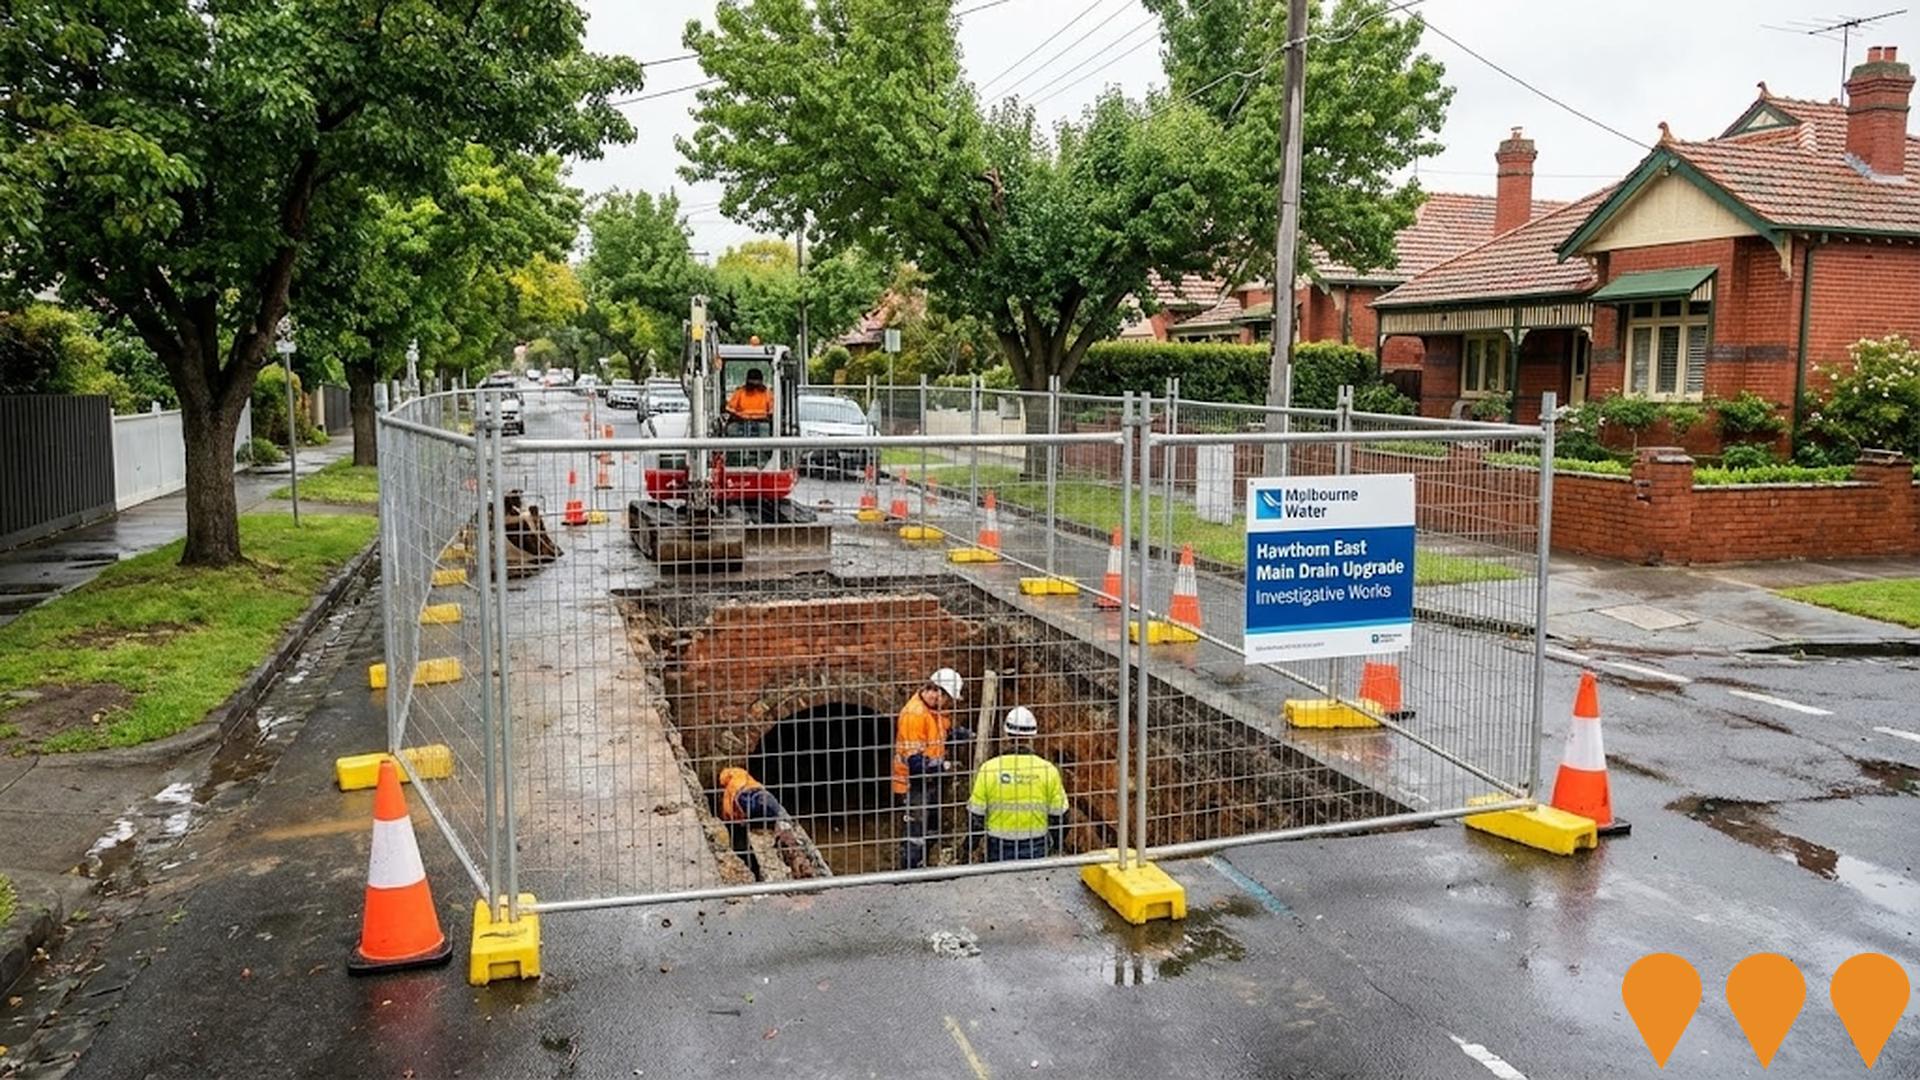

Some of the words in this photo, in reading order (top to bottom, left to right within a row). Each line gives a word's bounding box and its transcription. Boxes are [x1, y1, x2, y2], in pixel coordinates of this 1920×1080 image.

[1285, 505, 1327, 518] Water
[1256, 541, 1330, 560] Hawthorn
[1334, 540, 1367, 556] East
[1256, 564, 1295, 581] Main
[1299, 562, 1339, 579] Drain
[1343, 559, 1404, 579] Upgrade
[1256, 587, 1345, 606] Investigative
[1348, 583, 1392, 600] Works
